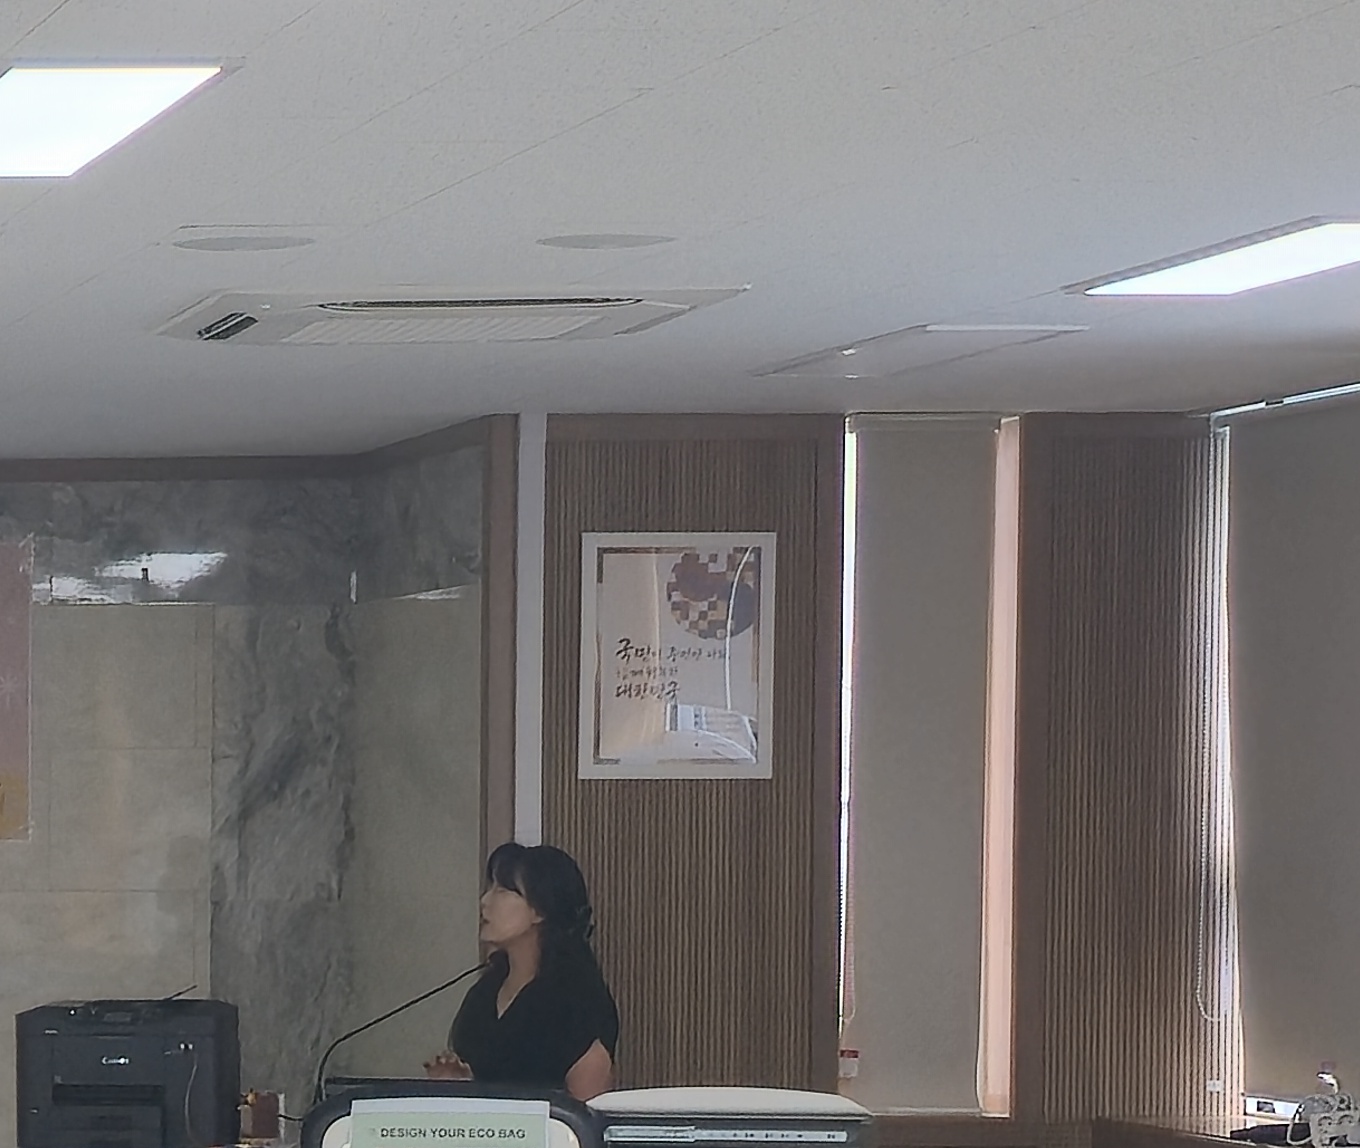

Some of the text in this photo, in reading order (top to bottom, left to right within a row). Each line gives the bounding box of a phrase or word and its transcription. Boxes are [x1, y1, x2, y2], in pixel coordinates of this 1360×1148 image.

[380, 1127, 527, 1139] DESIGN YOUR ECO BAG
